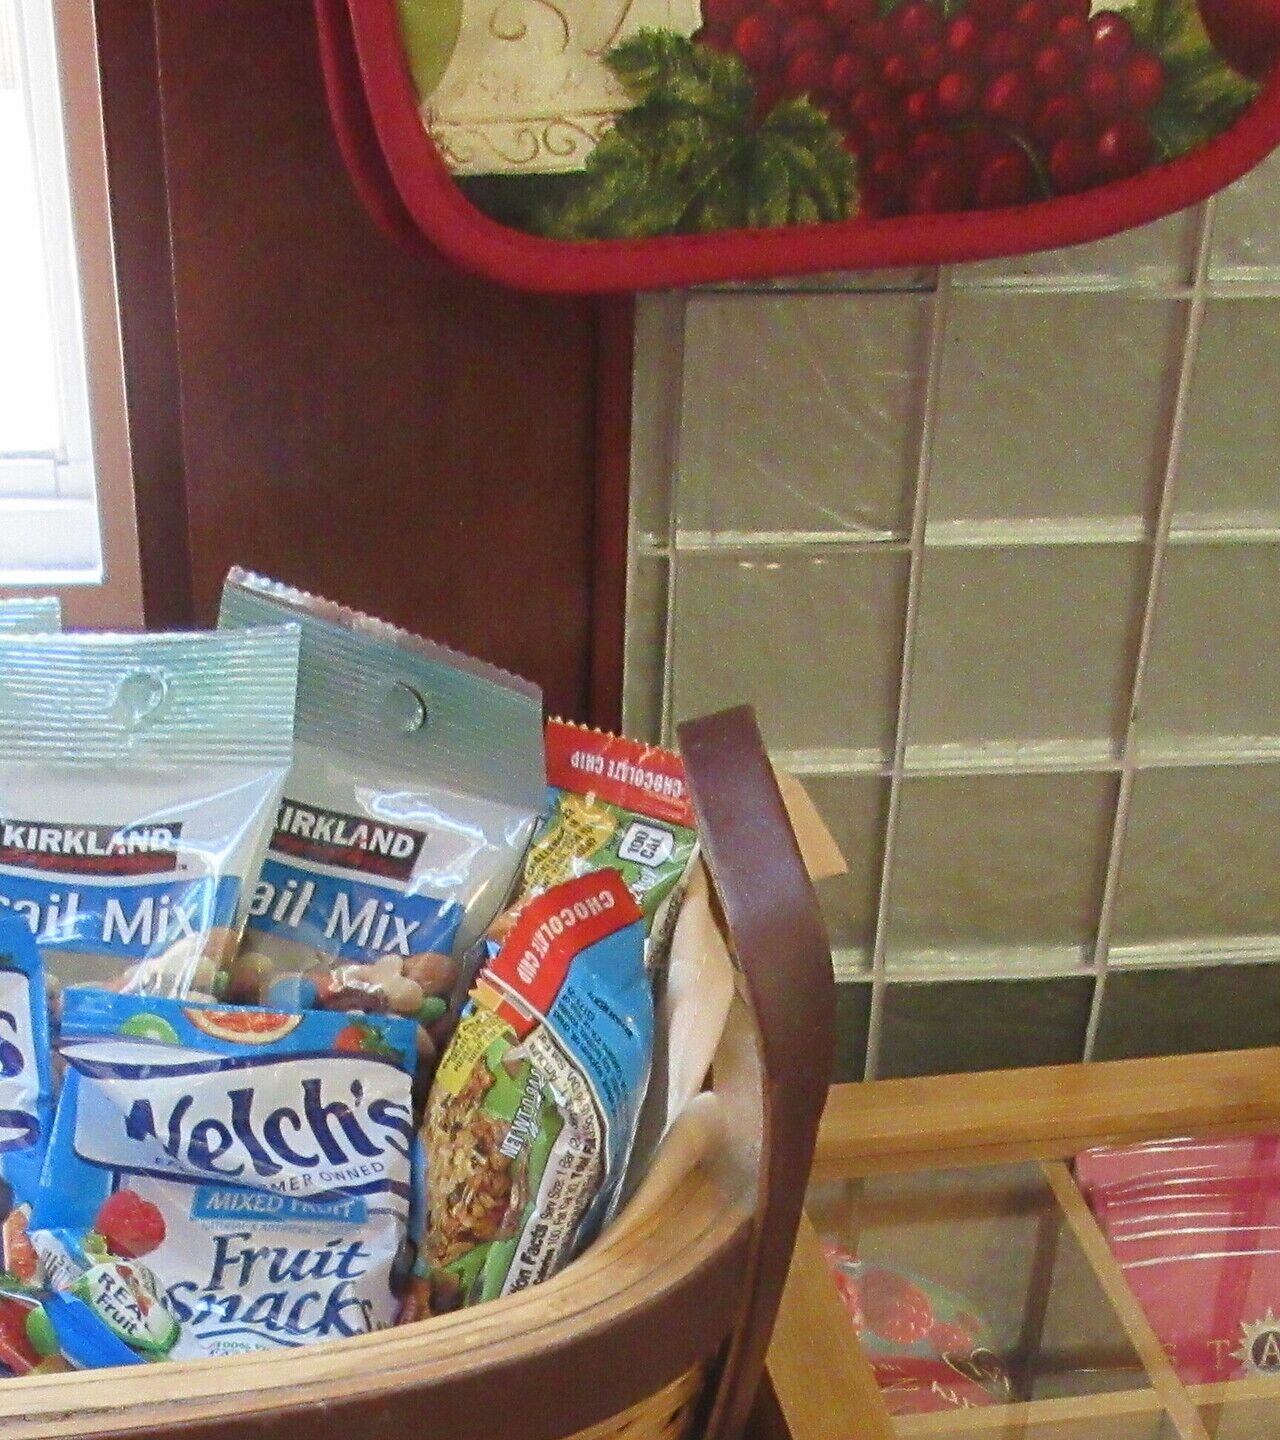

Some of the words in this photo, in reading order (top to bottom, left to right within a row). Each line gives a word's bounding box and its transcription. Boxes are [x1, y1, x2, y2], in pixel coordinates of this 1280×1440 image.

[2, 824, 175, 857] KIRKLAND
[281, 806, 416, 860] IRKLAND
[249, 879, 311, 929] ail
[323, 893, 422, 957] Mix
[319, 1160, 386, 1183] OWNED
[203, 1232, 371, 1291] Fruit
[96, 1292, 138, 1336] Fruit
